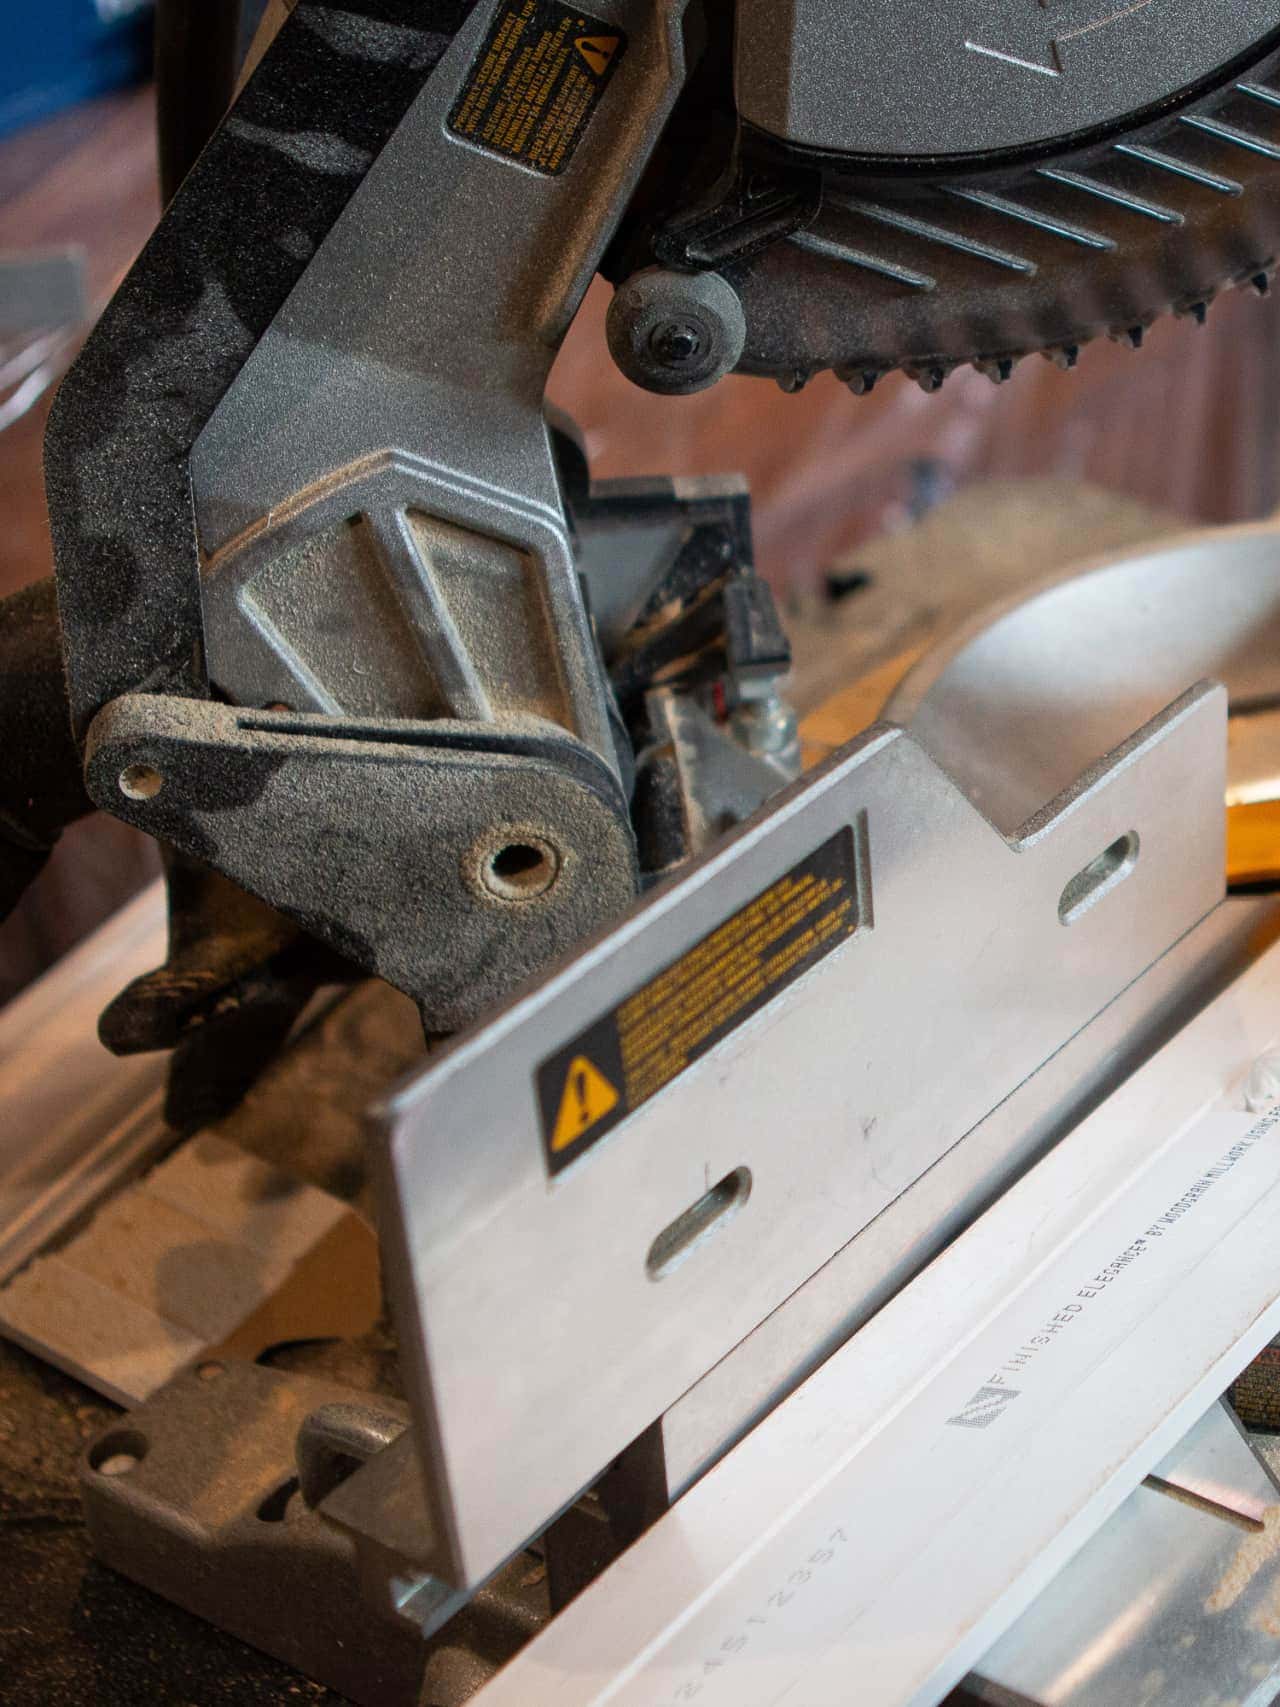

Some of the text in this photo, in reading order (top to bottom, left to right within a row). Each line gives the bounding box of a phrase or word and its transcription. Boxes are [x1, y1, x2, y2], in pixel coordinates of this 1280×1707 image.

[987, 1303, 1083, 1385] FINISHED
[1144, 1225, 1166, 1236] BY
[1158, 1180, 1215, 1224] WOODGRAIN
[1205, 1141, 1254, 1179] MILLWORK
